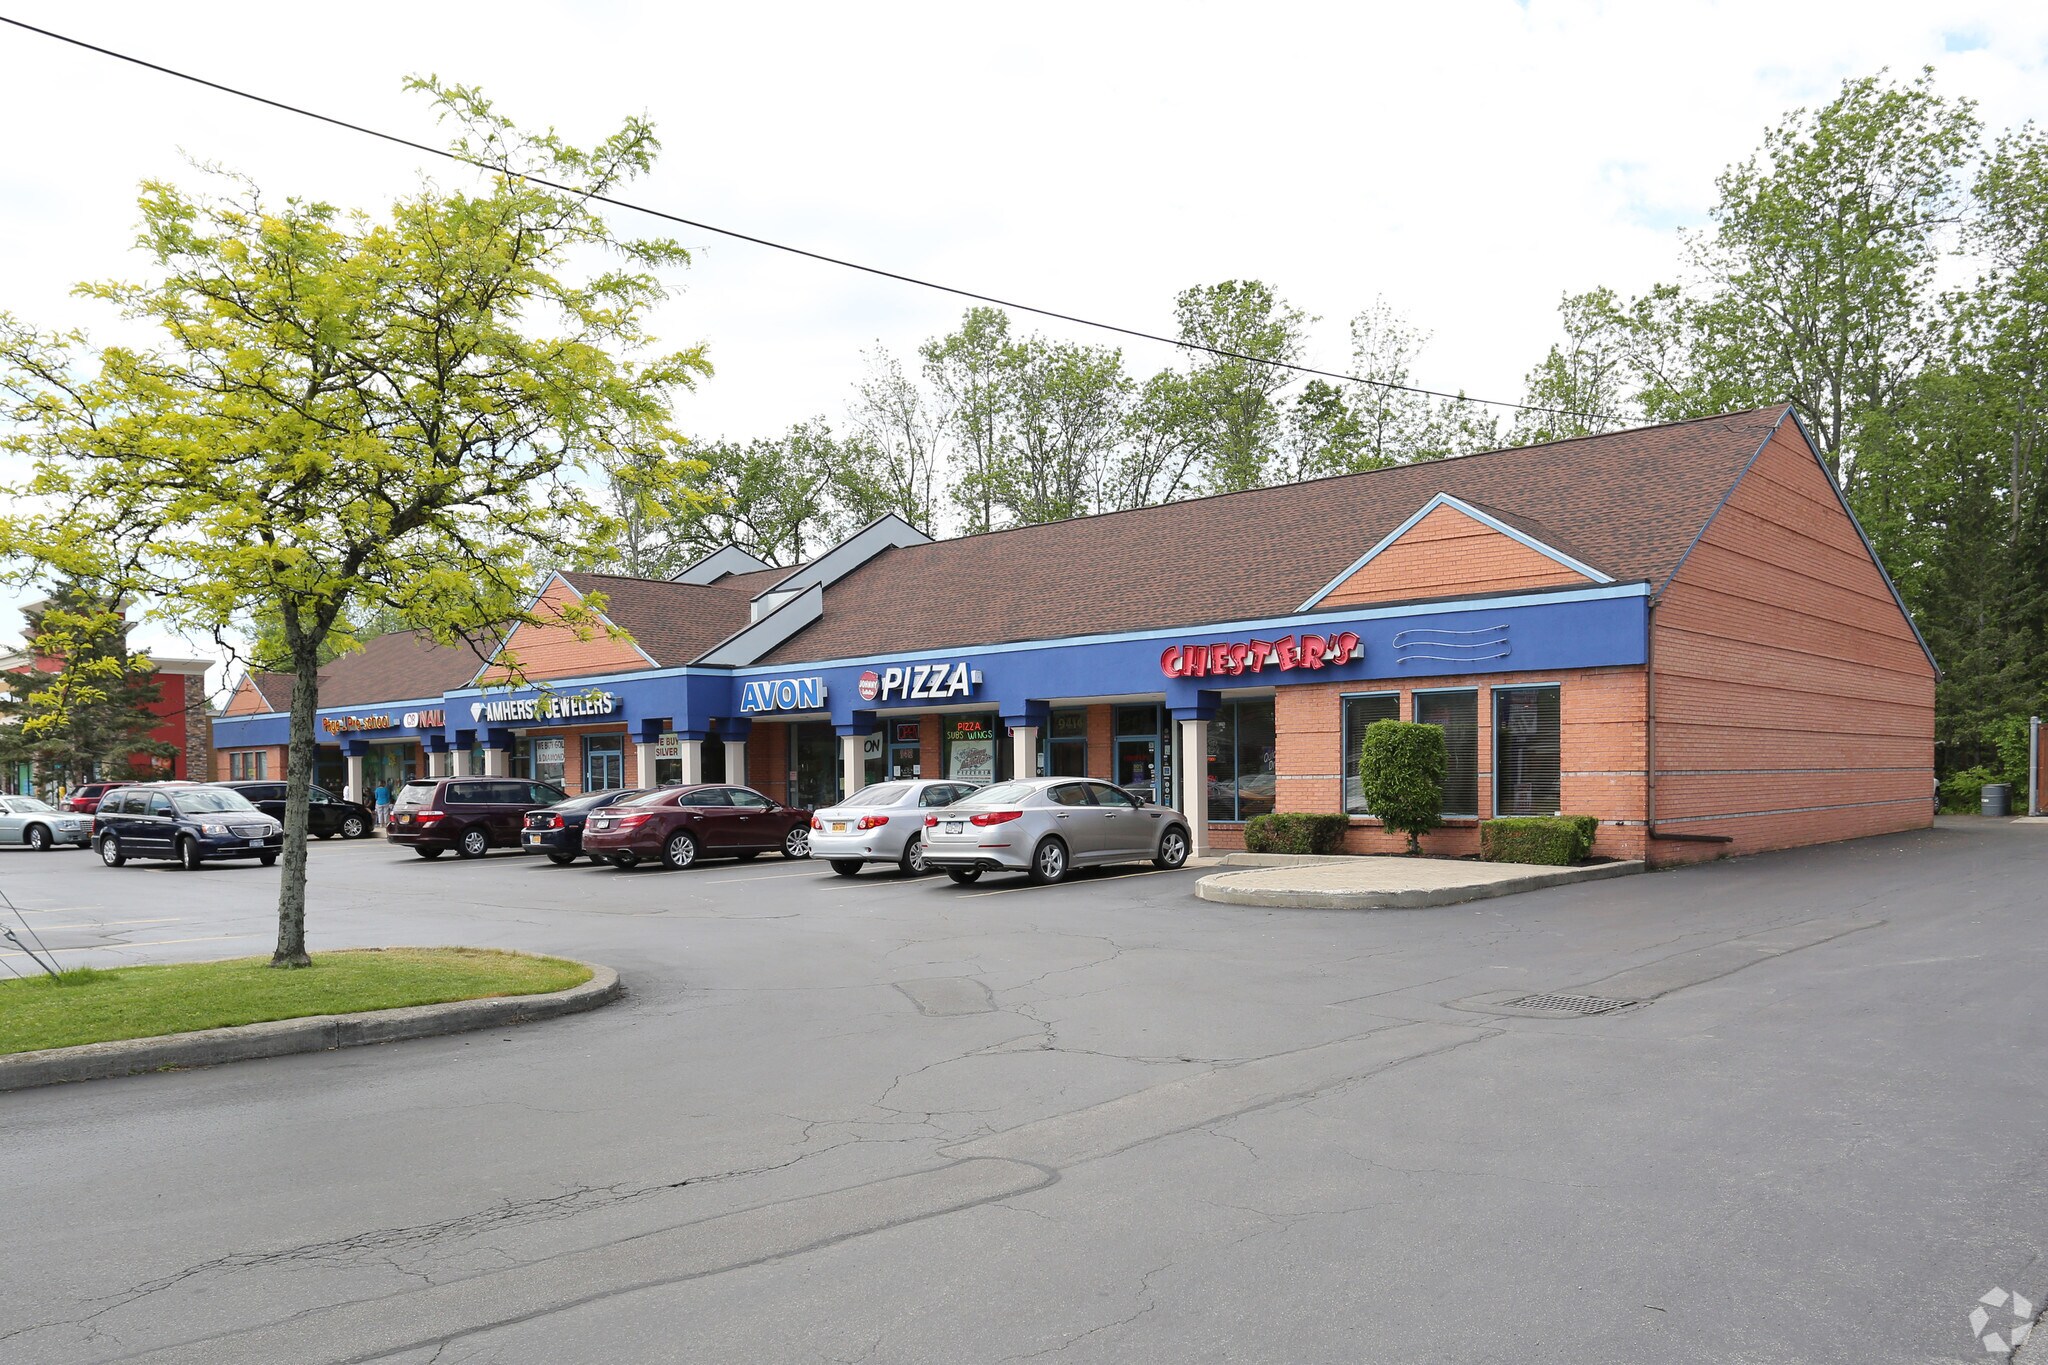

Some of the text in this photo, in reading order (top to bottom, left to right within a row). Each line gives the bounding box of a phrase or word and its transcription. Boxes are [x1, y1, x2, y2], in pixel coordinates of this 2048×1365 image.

[1160, 631, 1360, 678] CHESTER'S
[881, 662, 970, 701] PIZZA
[740, 677, 821, 712] AVON
[486, 691, 614, 723] AMHERST JEWELERS
[419, 709, 446, 728] NAIL
[957, 721, 981, 731] PIZZA
[666, 736, 679, 746] BUY
[947, 730, 993, 740] SUBS WINGS
[655, 747, 679, 757] SILVER
[864, 739, 880, 753] ON
